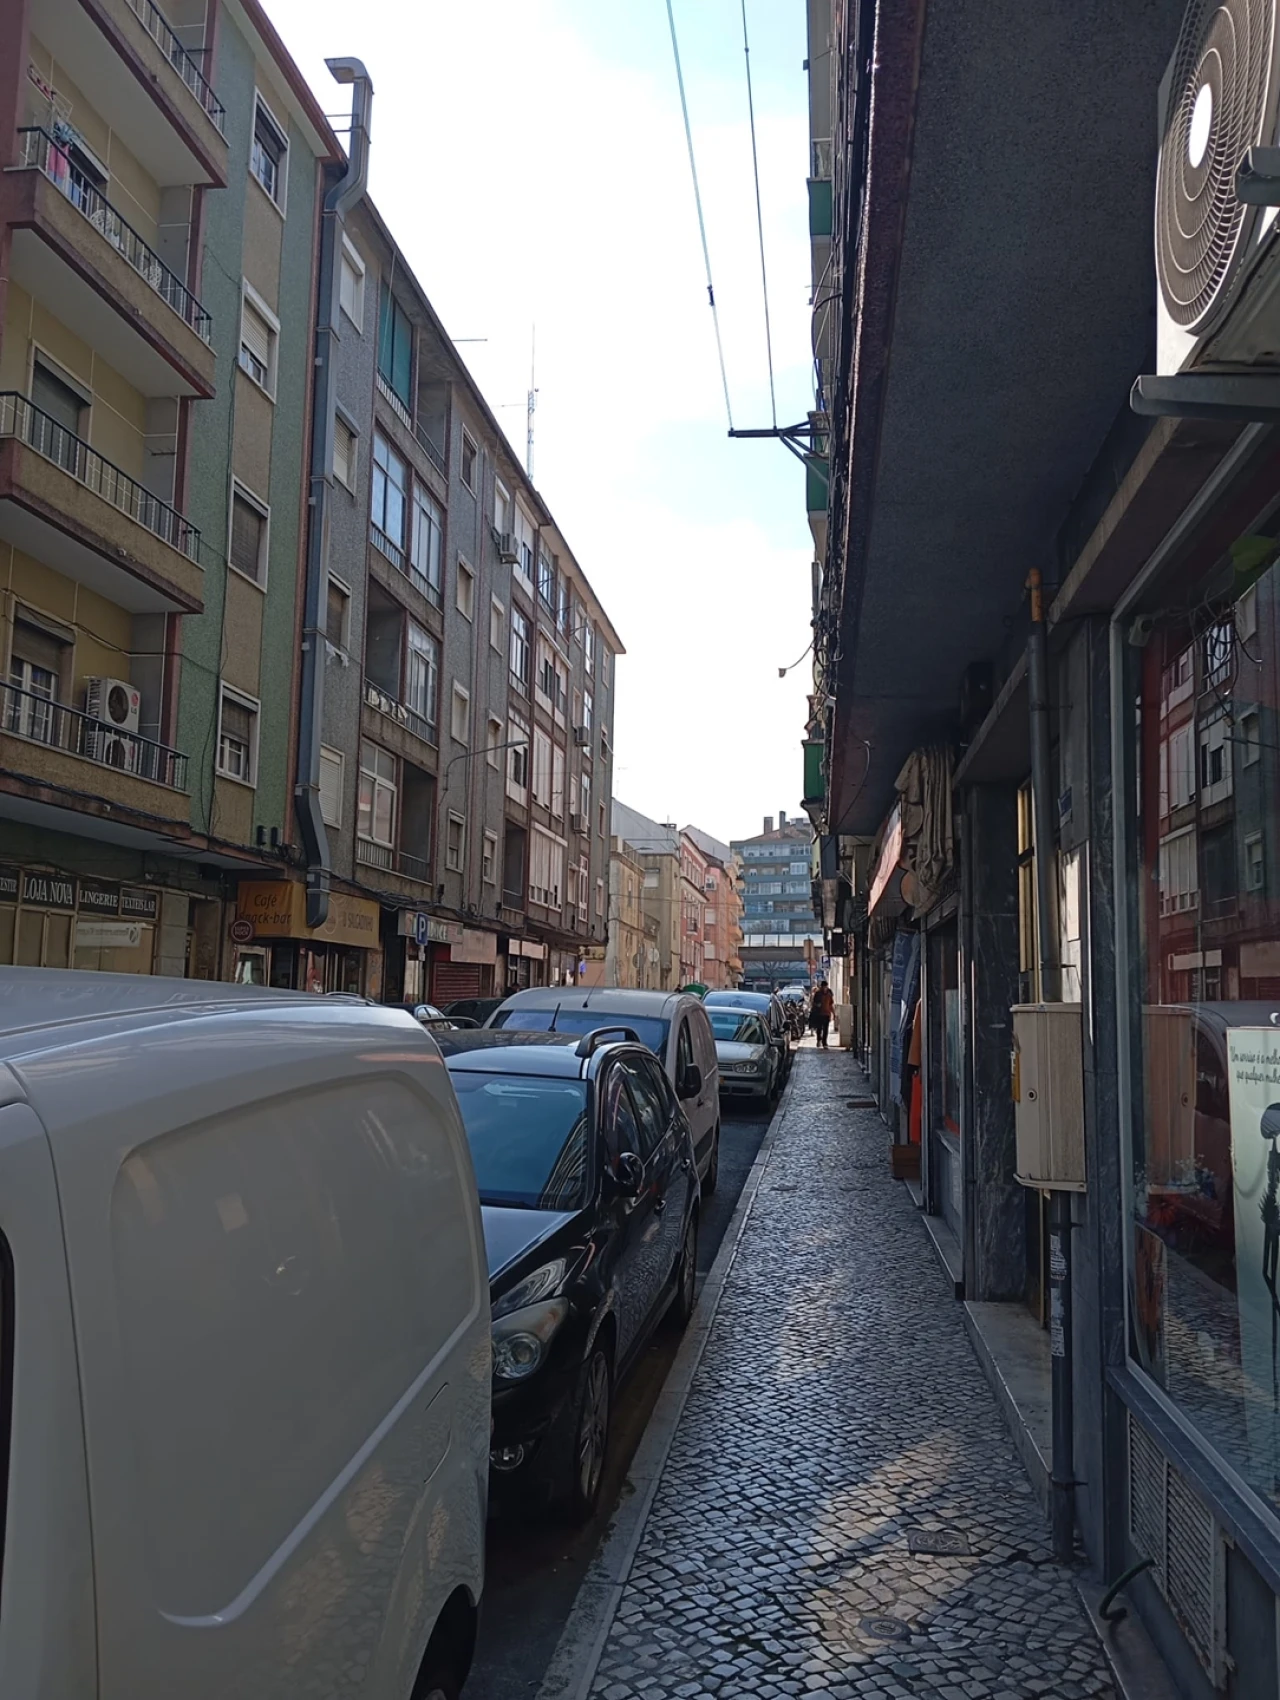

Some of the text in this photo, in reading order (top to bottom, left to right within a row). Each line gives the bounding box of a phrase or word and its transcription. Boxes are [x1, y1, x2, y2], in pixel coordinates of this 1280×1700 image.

[23, 877, 73, 905] LOJA NOVA
[79, 889, 118, 908] LINGERIE
[254, 894, 277, 910] Café
[419, 916, 426, 940] P
